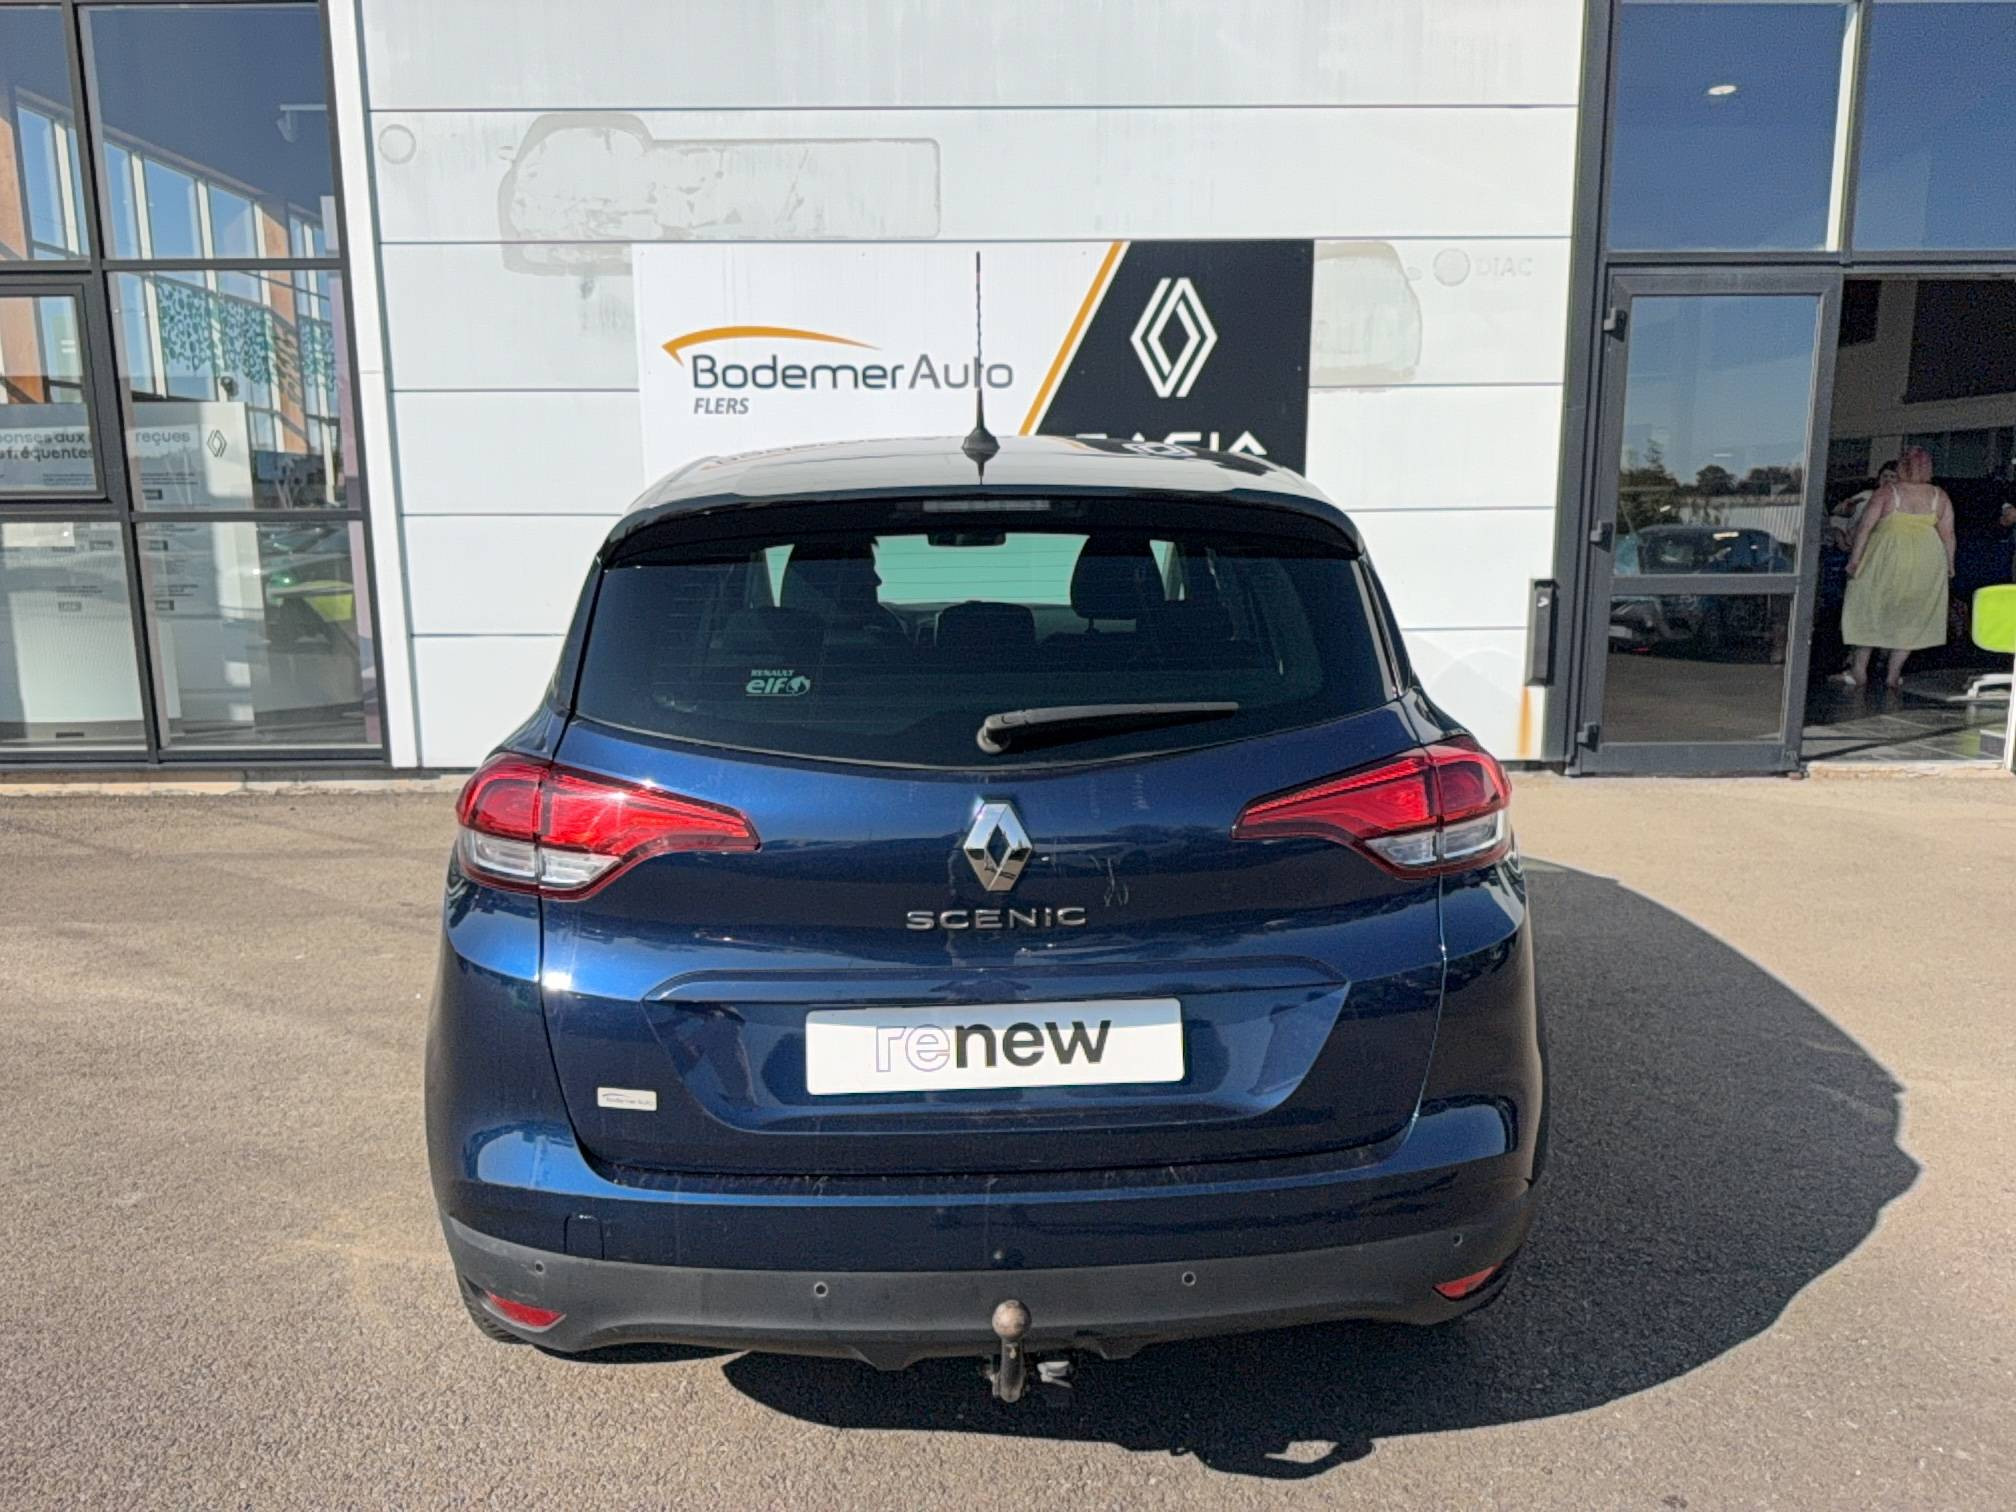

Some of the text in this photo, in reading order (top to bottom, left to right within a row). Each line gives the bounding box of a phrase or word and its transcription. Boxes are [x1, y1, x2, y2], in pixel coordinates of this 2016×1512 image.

[693, 397, 750, 415] FLERS
[54, 431, 86, 443] aux
[136, 430, 191, 446] reçues
[906, 906, 1087, 930] SCENIC
[875, 1019, 1112, 1073] renew
